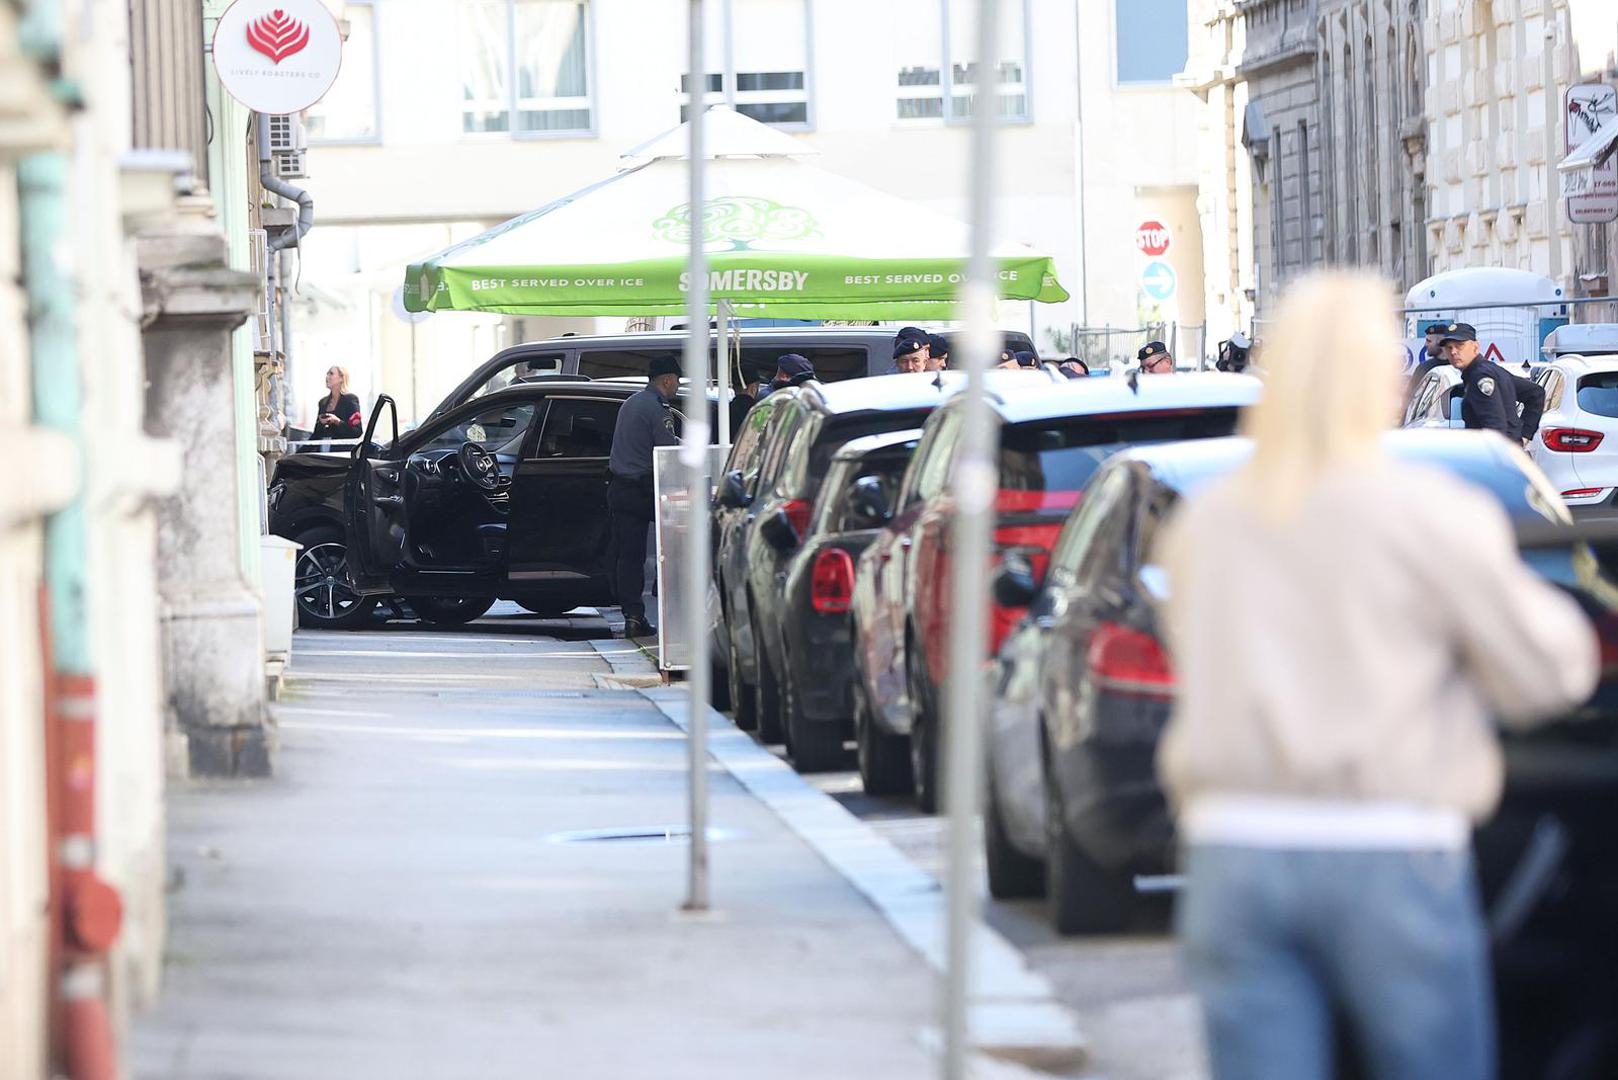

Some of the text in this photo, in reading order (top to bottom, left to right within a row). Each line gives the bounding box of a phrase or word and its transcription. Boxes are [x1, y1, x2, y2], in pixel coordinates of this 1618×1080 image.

[1136, 229, 1168, 249] STOP
[471, 278, 644, 291] BEST SERVED OVER ICE
[844, 275, 879, 285] BEST
[885, 273, 944, 284] SERVED
